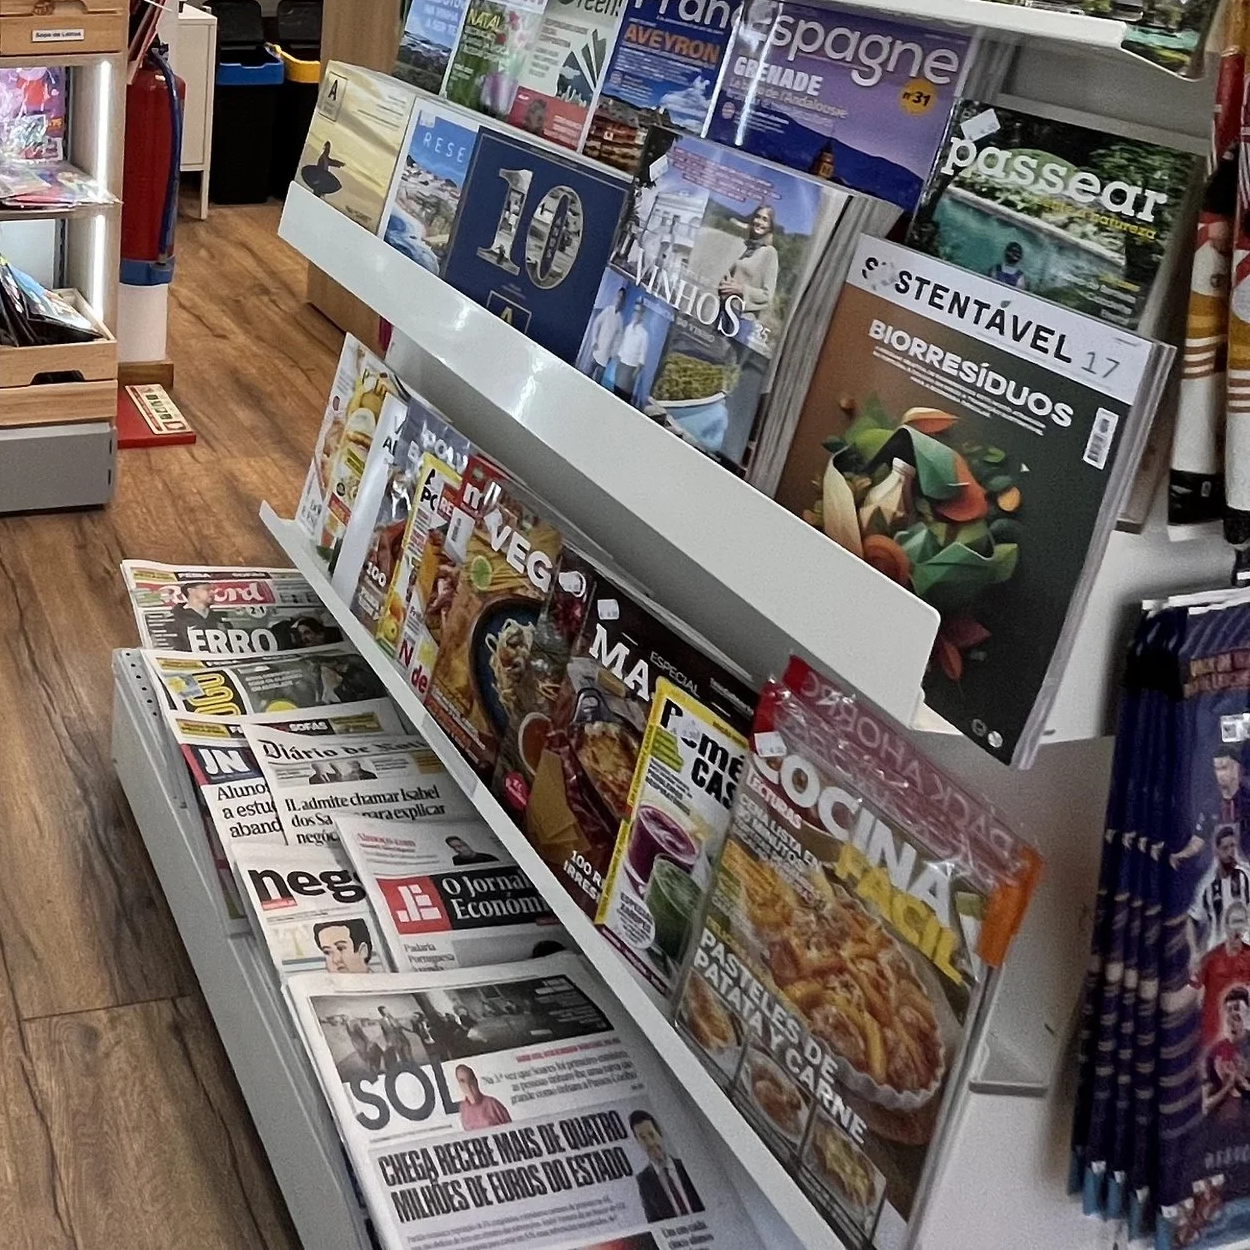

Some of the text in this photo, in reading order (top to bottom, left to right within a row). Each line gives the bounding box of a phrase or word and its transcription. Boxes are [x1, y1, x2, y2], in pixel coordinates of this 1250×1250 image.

[623, 23, 722, 65] AVEYRON
[423, 131, 466, 163] RESE
[940, 137, 1169, 223] passear
[476, 167, 584, 290] 10
[862, 257, 1073, 364] SSTENTÁVEL
[1081, 351, 1122, 379] 17
[868, 319, 1074, 428] BIORRESÍDUOS
[484, 521, 553, 594] VEG
[158, 581, 265, 604] Rord
[188, 627, 279, 653] ERRO
[411, 664, 428, 694] de
[589, 622, 650, 702] MA
[650, 651, 700, 695] ESPECIAL
[288, 721, 329, 734] SOFÁS
[199, 749, 251, 775] JN
[258, 738, 338, 762] Diário
[222, 807, 233, 820] a
[291, 813, 313, 828] dos
[392, 803, 446, 821] explicar
[301, 795, 350, 811] admite
[350, 789, 399, 807] chamar
[400, 784, 441, 801] Isabel
[747, 769, 802, 829] LECTURAS
[230, 817, 284, 839] aband
[571, 849, 594, 875] 100
[442, 868, 529, 899] O Jornal
[700, 927, 838, 1084] PASTELES DE
[693, 947, 868, 1145] PATATA Y CARNE
[350, 1059, 460, 1131] SOL
[377, 1109, 628, 1188] CHEGA RECEBE MAIS DE QUATRO
[465, 1174, 493, 1209] DE
[489, 1164, 549, 1204] EUROS
[541, 1157, 573, 1194] DO
[566, 1146, 634, 1184] ESTADO
